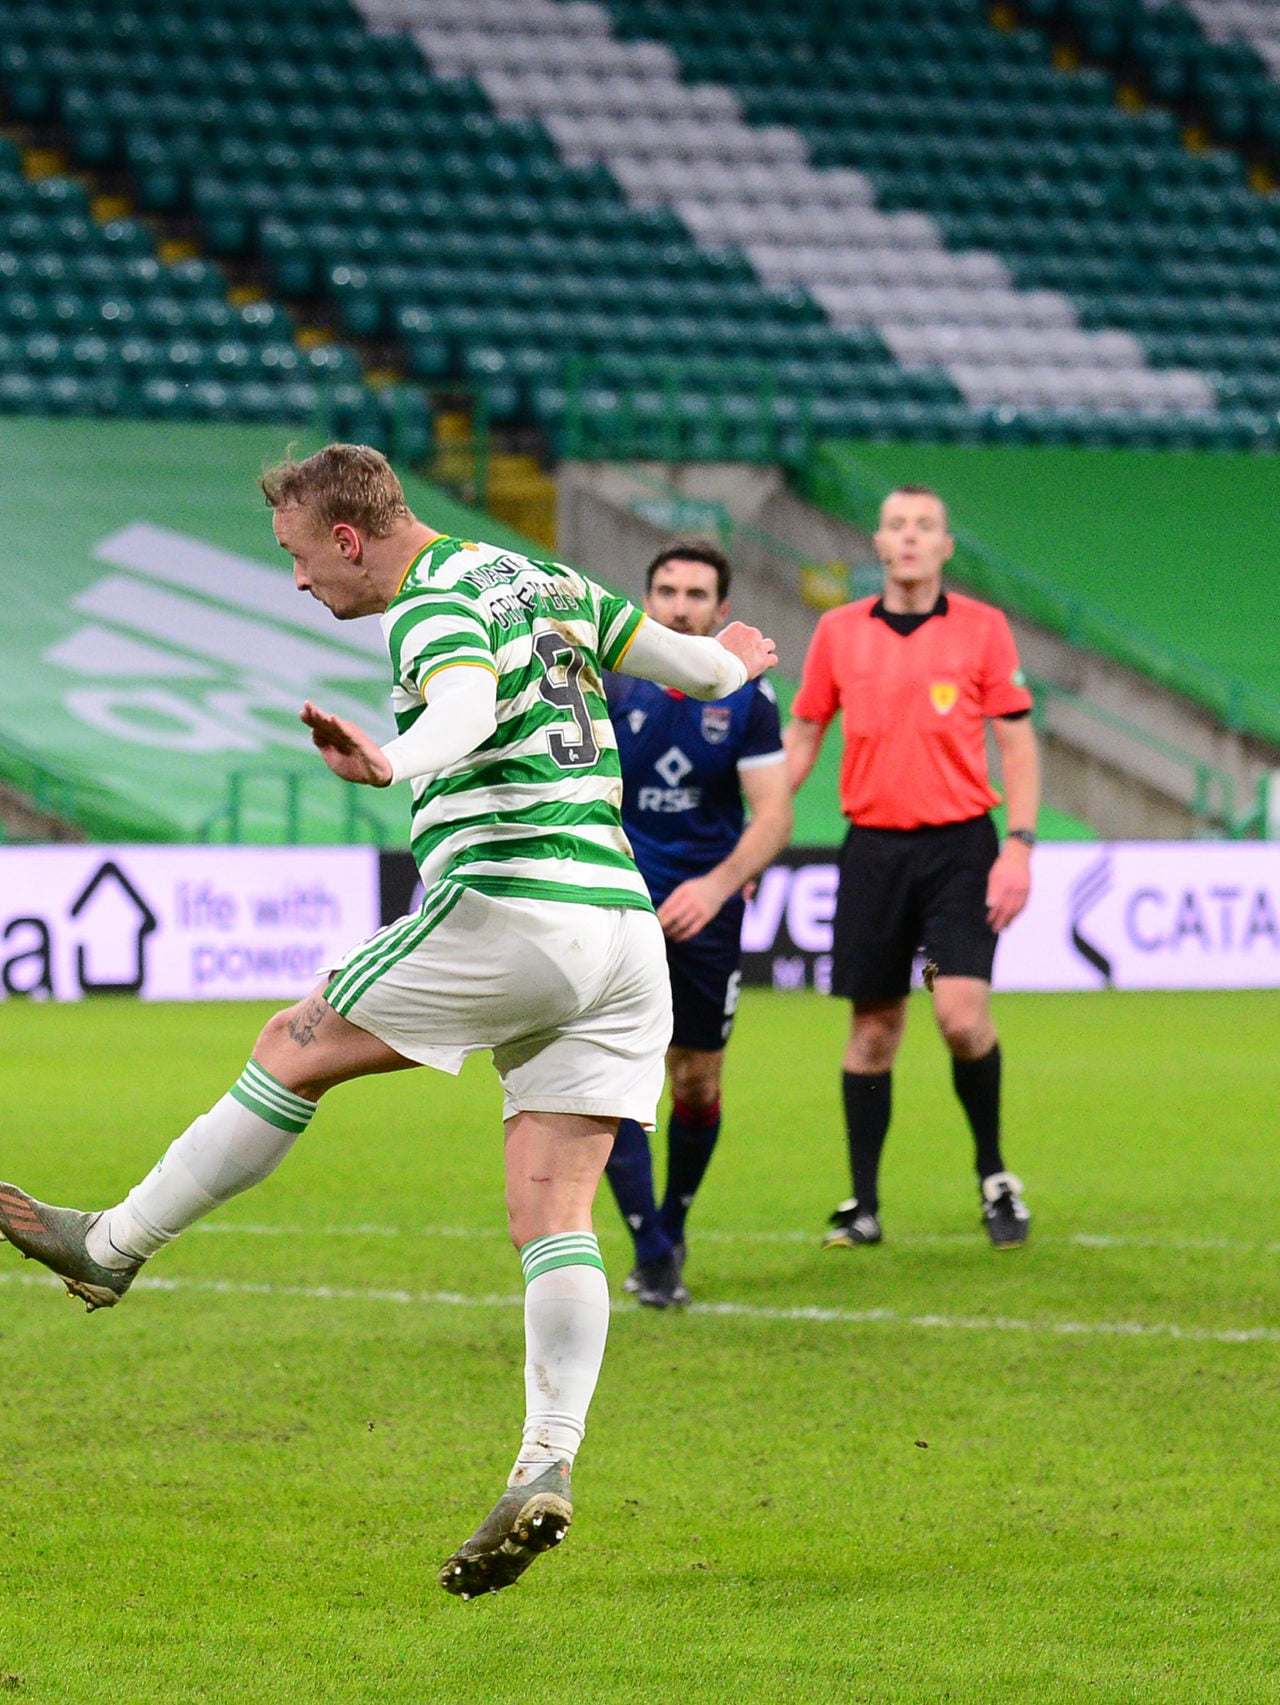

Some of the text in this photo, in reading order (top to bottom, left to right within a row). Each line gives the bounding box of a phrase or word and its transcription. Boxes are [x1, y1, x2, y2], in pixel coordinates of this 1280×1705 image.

[533, 630, 600, 769] 9
[639, 786, 701, 813] RSE
[175, 878, 342, 932] life with
[740, 864, 840, 952] VE
[191, 943, 325, 998] power
